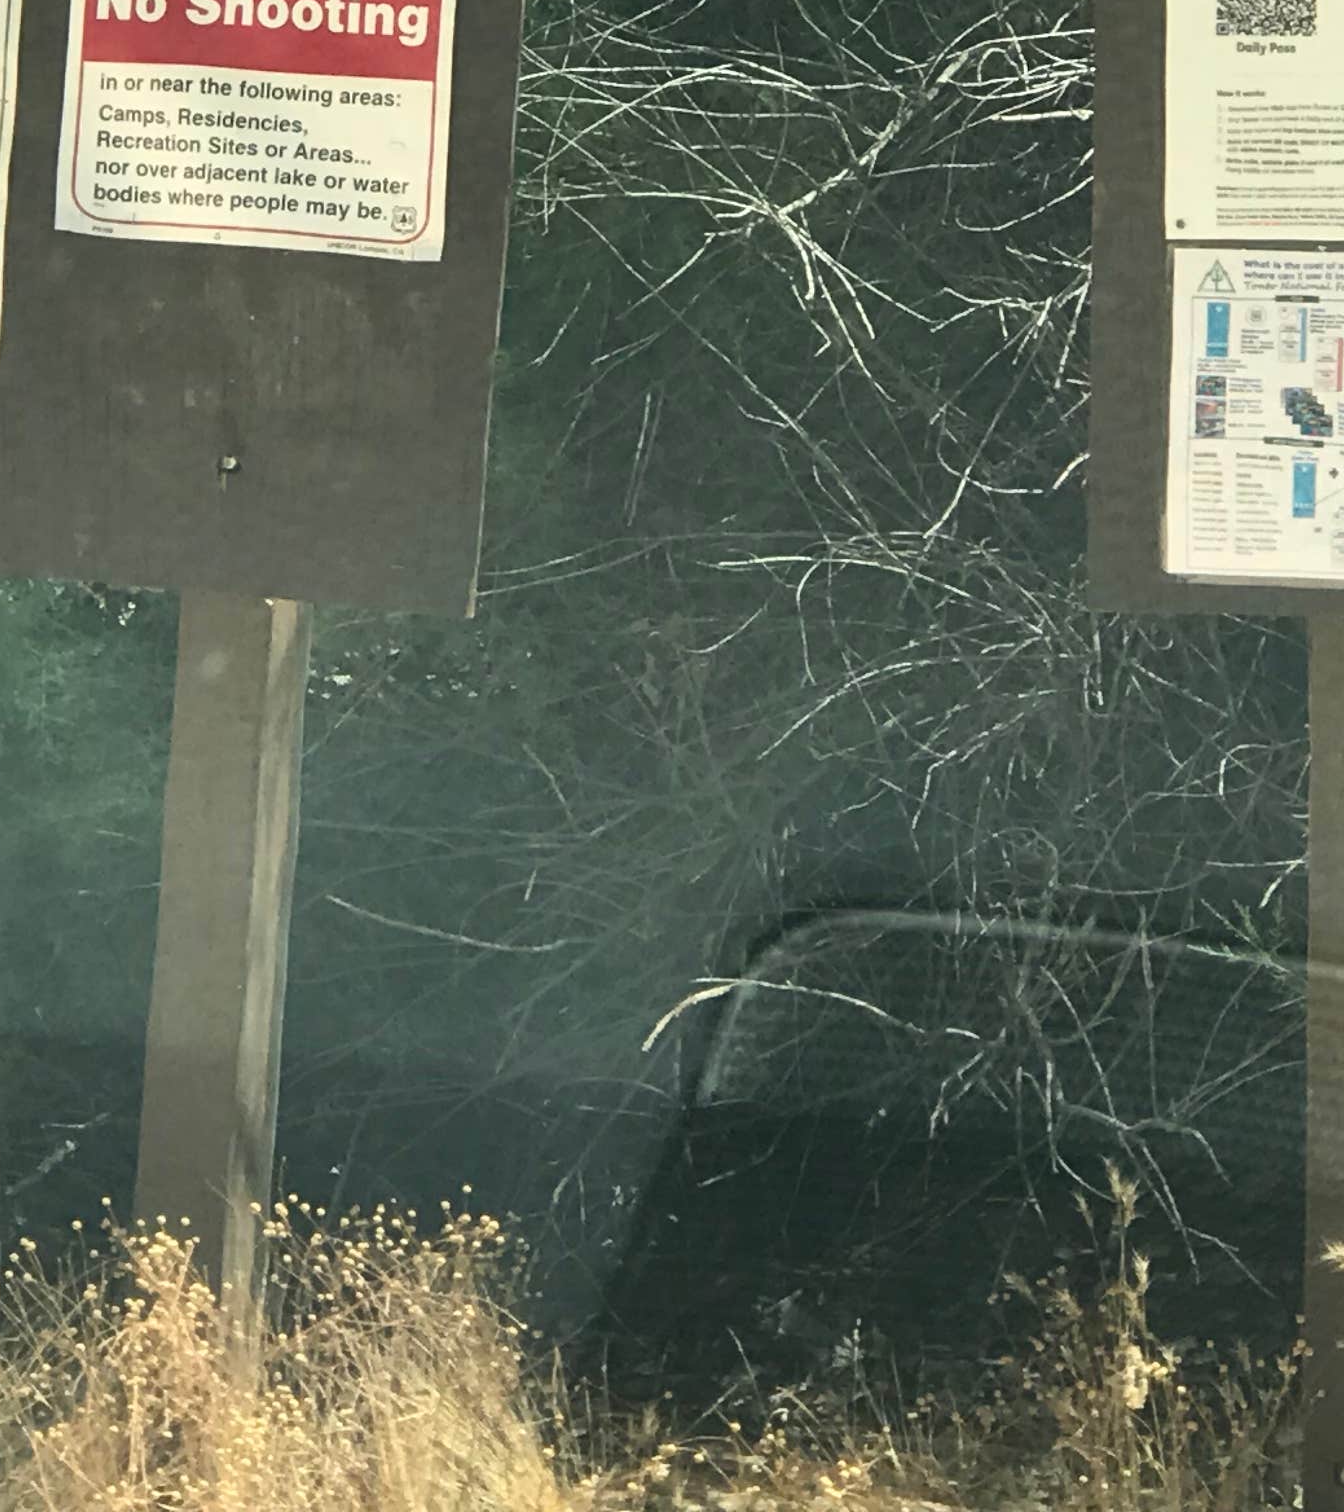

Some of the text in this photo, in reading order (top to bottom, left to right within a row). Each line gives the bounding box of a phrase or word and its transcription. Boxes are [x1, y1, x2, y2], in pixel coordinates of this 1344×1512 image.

[1236, 42, 1296, 56] Daily Pass
[100, 74, 400, 107] in or near the following areas:
[99, 104, 308, 135] Camps, Residencies,
[97, 130, 370, 164] Recreation Sites or Areas...
[95, 161, 408, 194] nor over adjacent lake or water
[93, 183, 386, 221] bodies where people may be.
